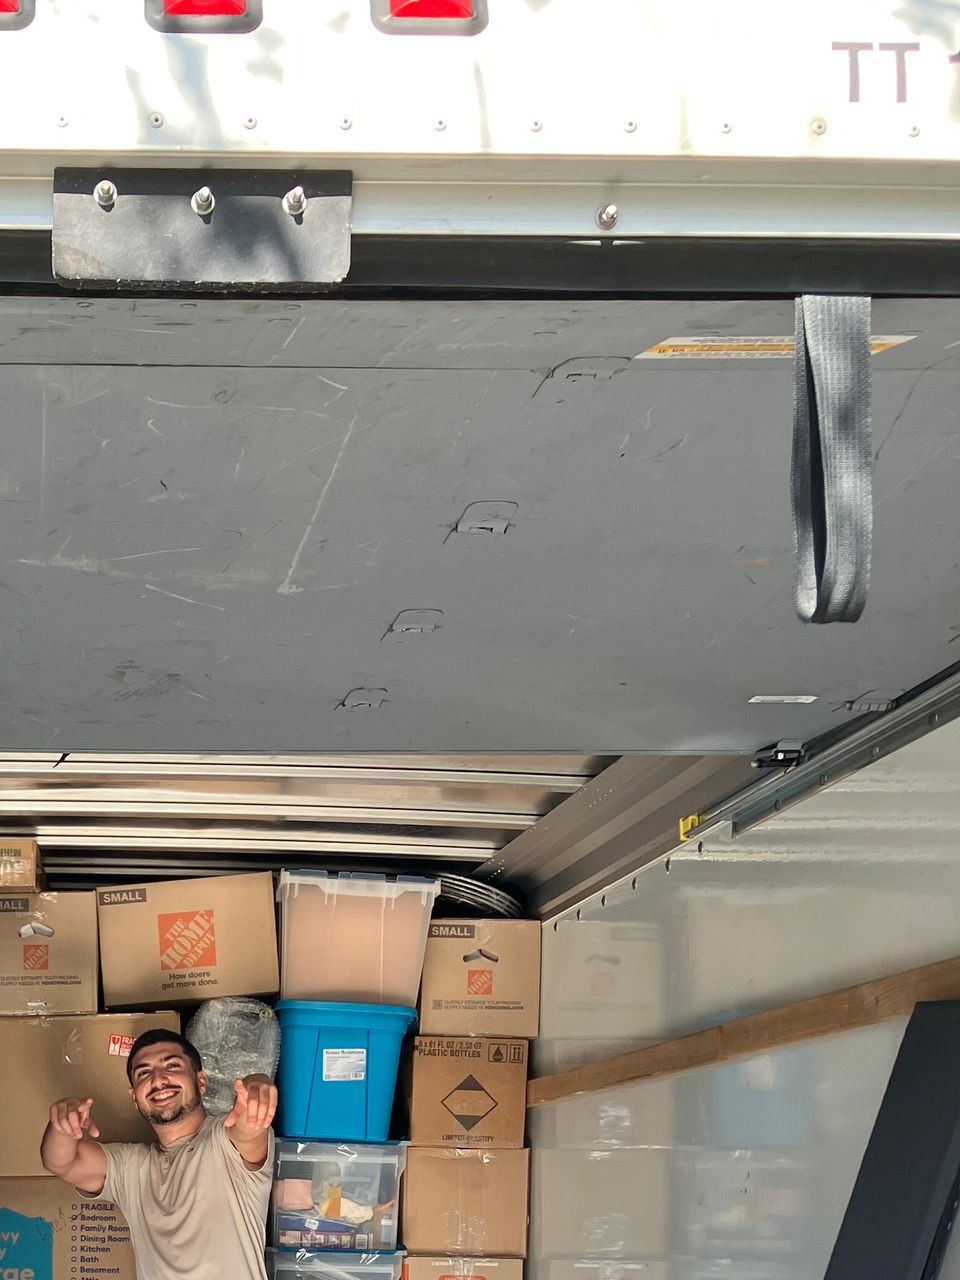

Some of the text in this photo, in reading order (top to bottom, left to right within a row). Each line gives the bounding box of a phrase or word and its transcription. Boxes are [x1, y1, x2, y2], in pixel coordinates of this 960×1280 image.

[103, 892, 143, 903] SMALL
[431, 926, 471, 936] SMALL
[160, 910, 214, 970] HOME
[188, 971, 211, 979] doers
[161, 981, 175, 991] get
[176, 979, 197, 988] more
[437, 1040, 445, 1049] FL
[447, 1041, 455, 1049] OZ
[419, 1048, 481, 1058] PLASTIC BOTTLES
[442, 1134, 466, 1142] LIMITED
[81, 1213, 117, 1221] Bedroom
[81, 1225, 107, 1233] Family
[81, 1235, 130, 1244] Dining Room
[81, 1245, 111, 1253] Kitchen
[81, 1266, 120, 1274] Basement
